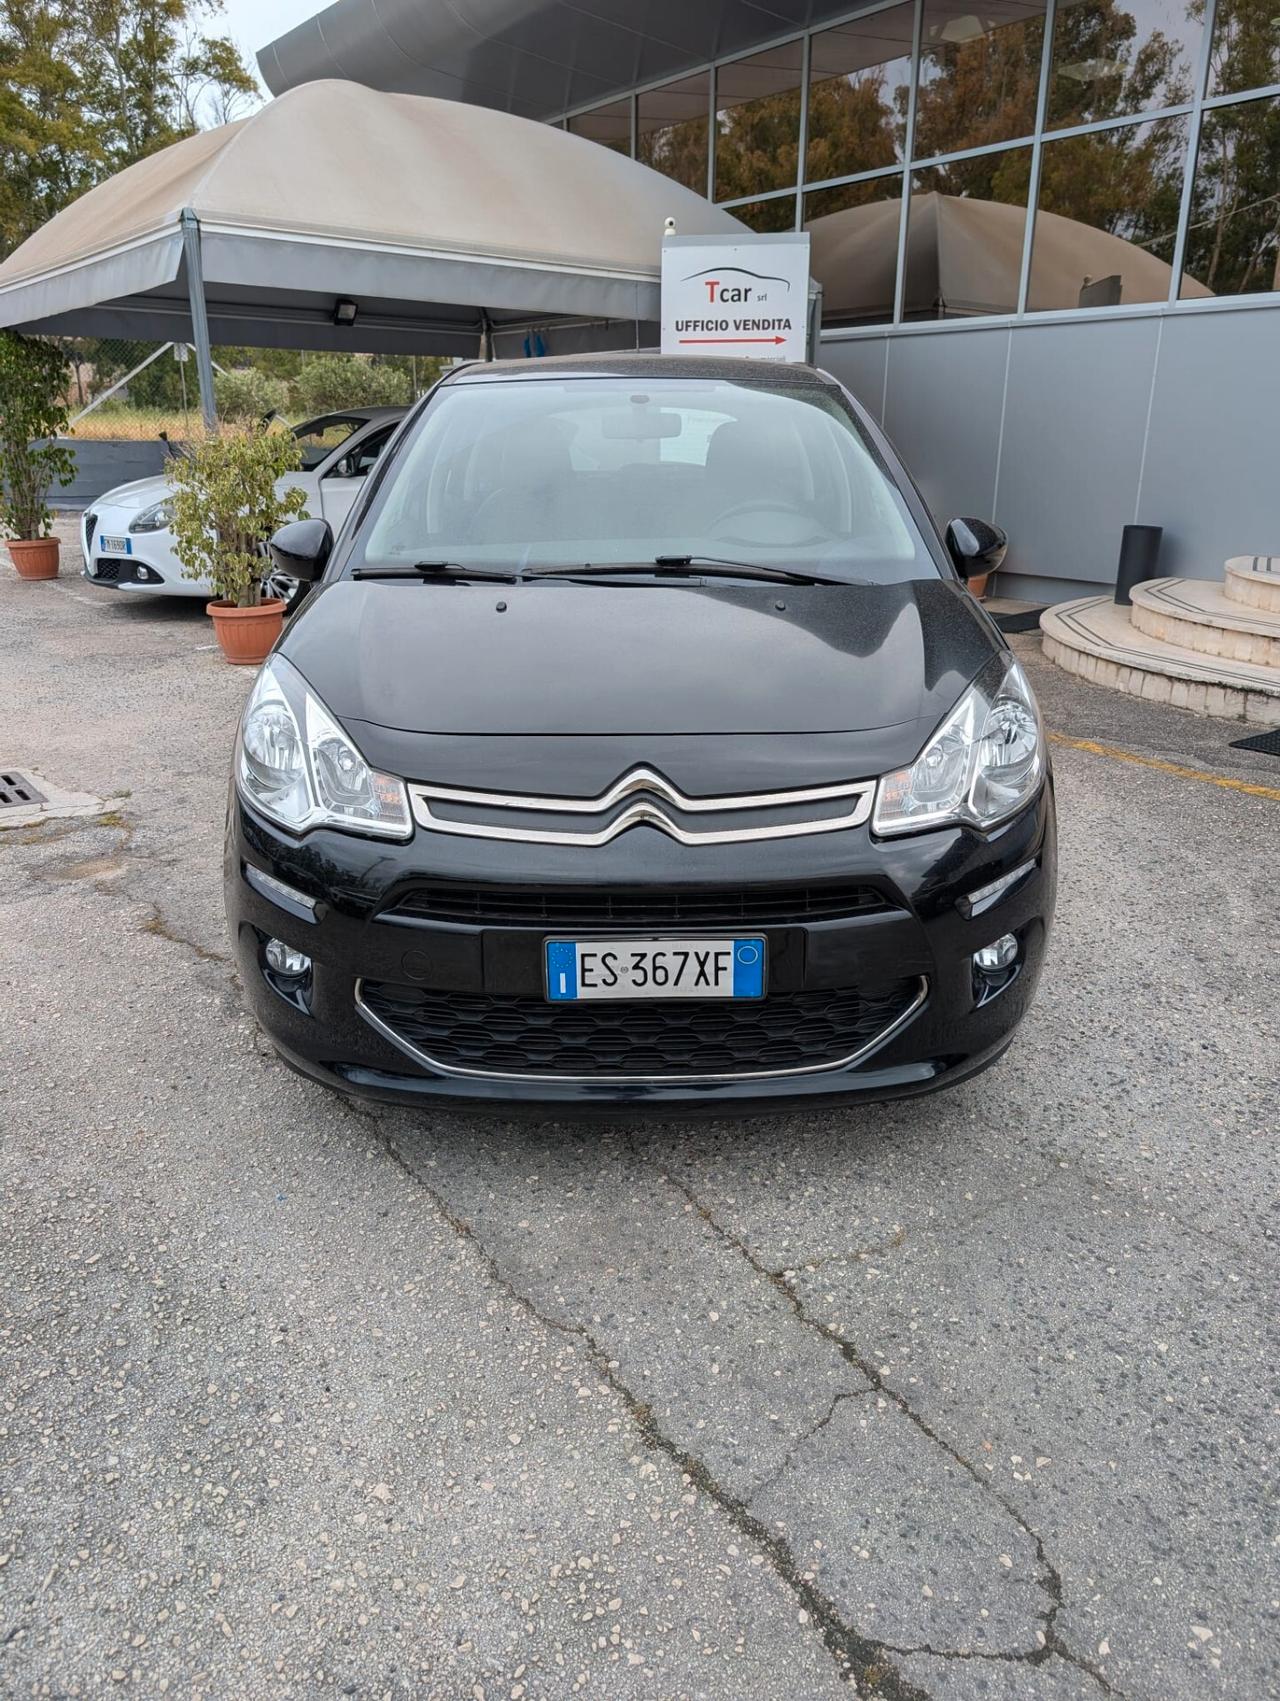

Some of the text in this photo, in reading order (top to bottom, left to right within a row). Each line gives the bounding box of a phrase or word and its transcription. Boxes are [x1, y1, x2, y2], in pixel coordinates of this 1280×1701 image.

[705, 281, 767, 303] Tcar srl
[675, 318, 792, 332] UFFICIO VENDITA
[580, 951, 731, 987] ES 367XF
